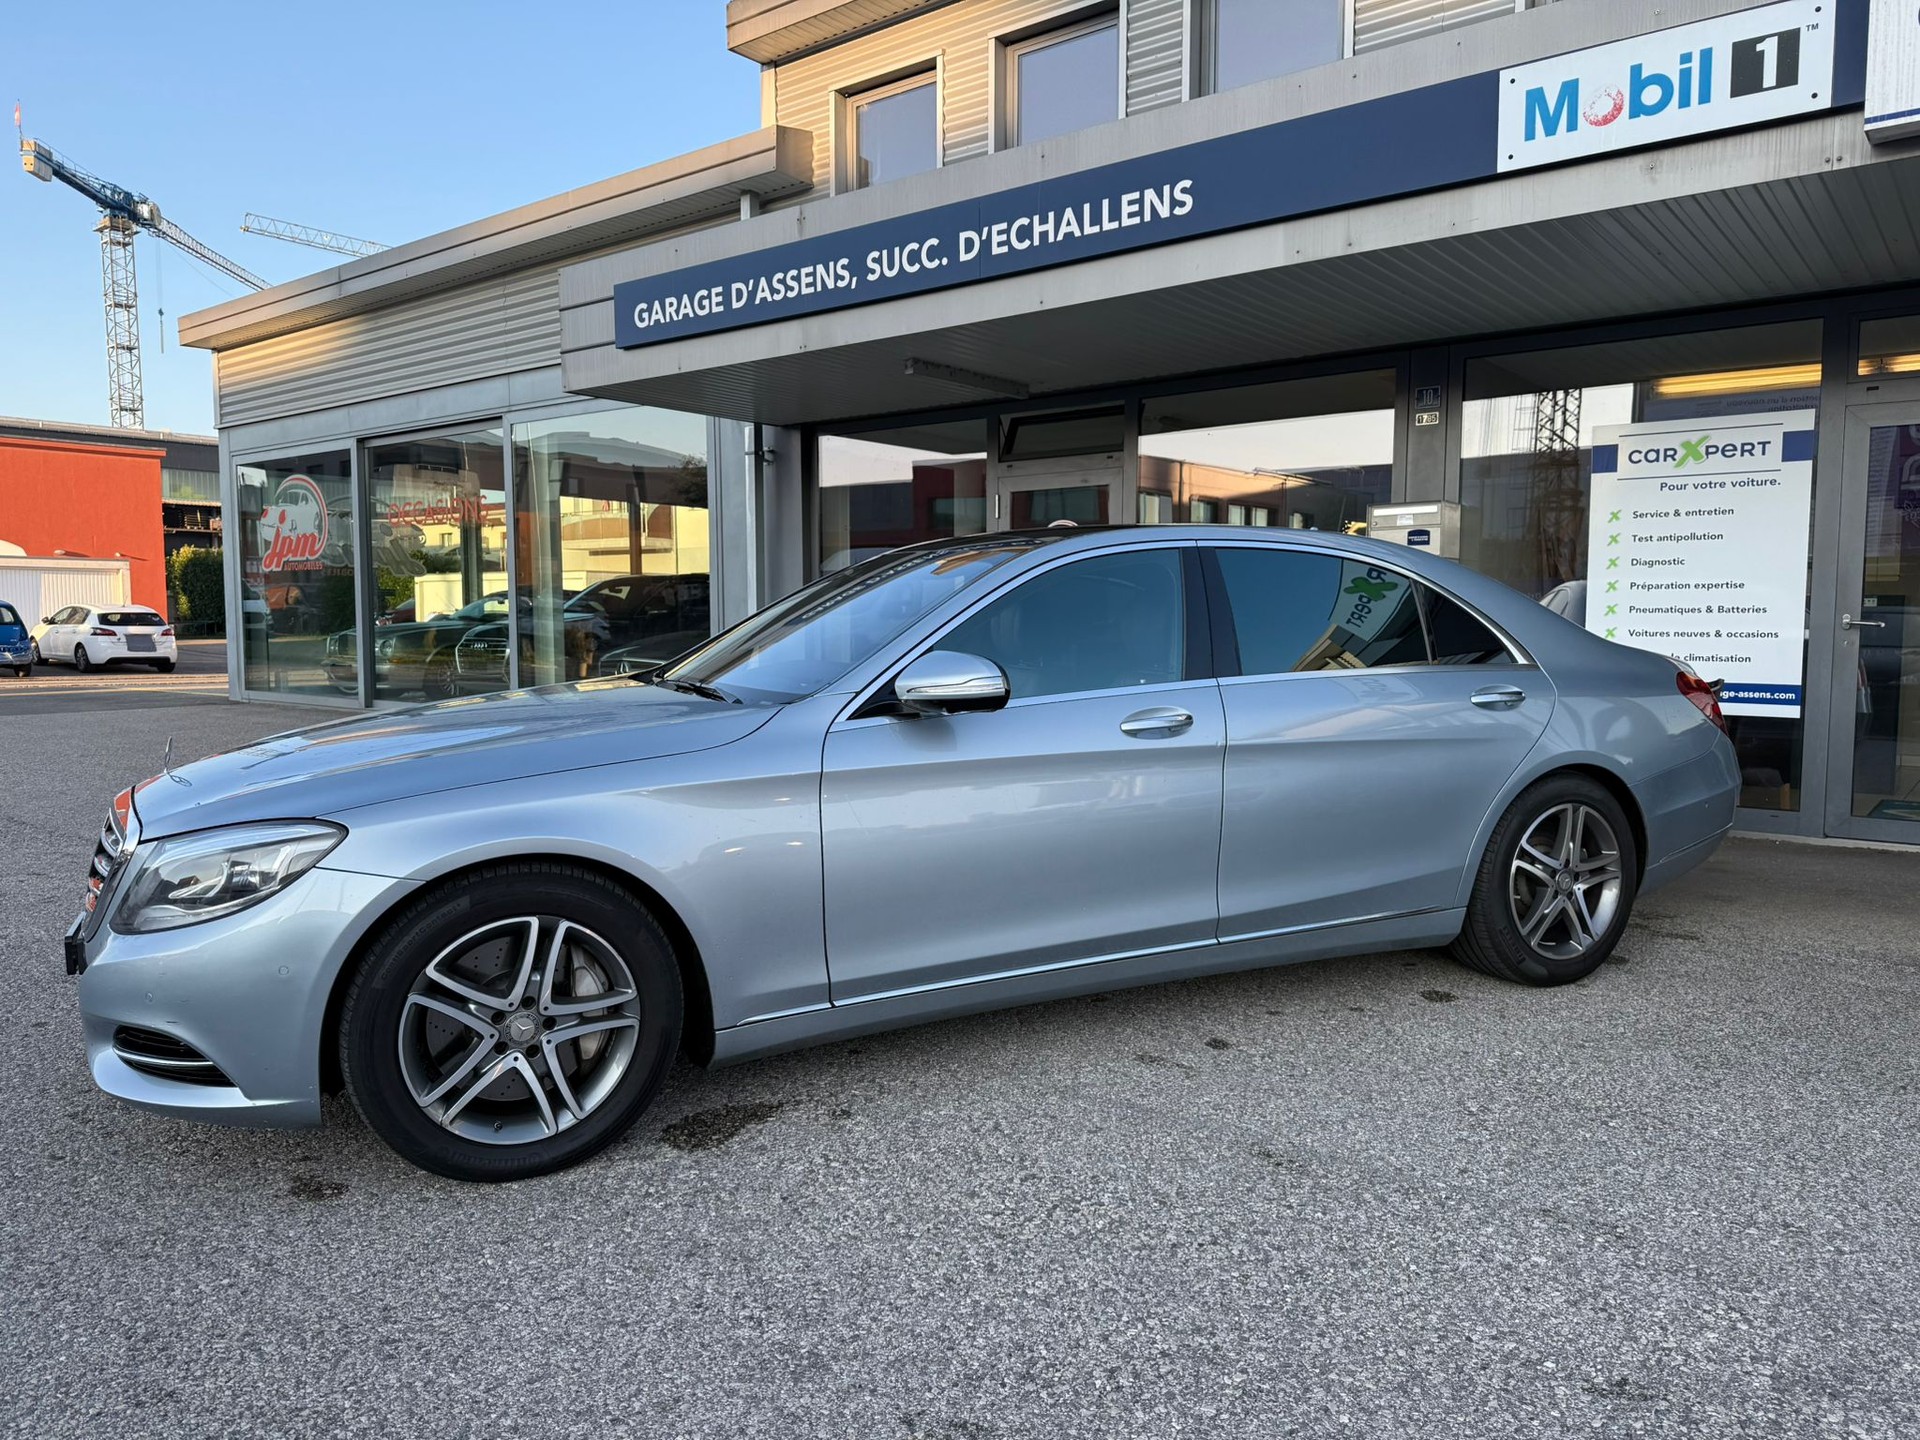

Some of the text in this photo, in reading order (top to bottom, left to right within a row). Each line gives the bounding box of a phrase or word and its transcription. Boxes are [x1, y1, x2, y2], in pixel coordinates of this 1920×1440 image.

[1524, 47, 1713, 142] Mobil
[1755, 36, 1778, 89] 1
[634, 180, 1194, 329] GARAGE D'ASSENS, SUCC. D'ECHALLENS
[1660, 477, 1781, 492] Pour votre voiture.
[388, 495, 489, 527] OCCASIONS
[1632, 506, 1734, 519] Service & entretien
[1632, 532, 1724, 544] Test antipollution
[283, 561, 323, 571] AUTOMOBILES
[1630, 557, 1685, 568] Diagnostic
[1630, 581, 1745, 592] Préparation expertise
[1628, 604, 1767, 616] Pneumatiques & Batteries
[1628, 629, 1779, 639] Voitures neuves & occasions
[1683, 652, 1751, 663] climatisation
